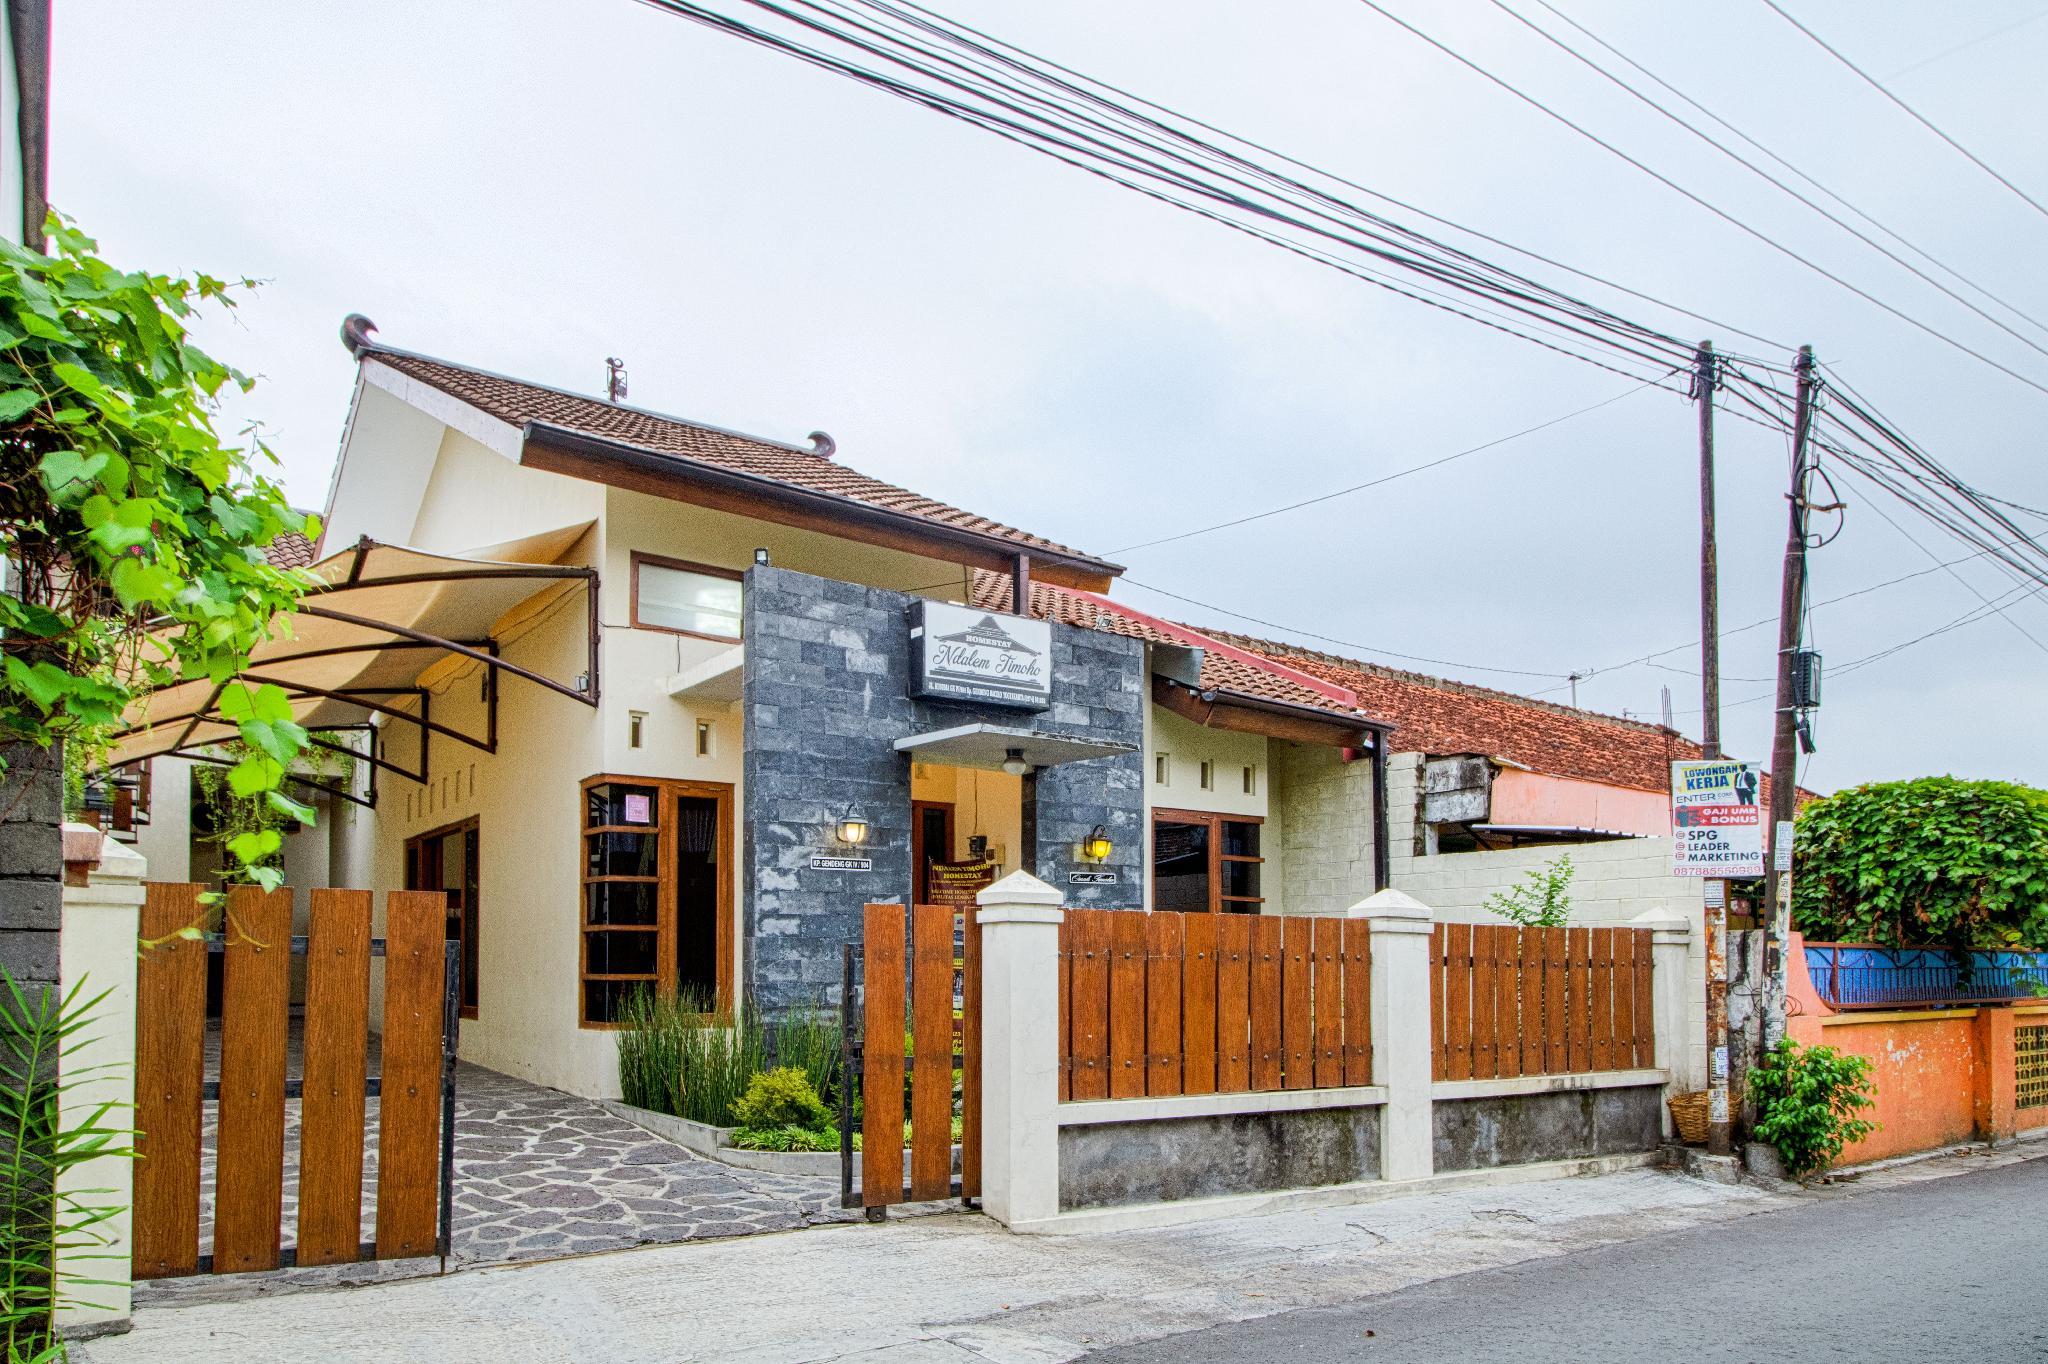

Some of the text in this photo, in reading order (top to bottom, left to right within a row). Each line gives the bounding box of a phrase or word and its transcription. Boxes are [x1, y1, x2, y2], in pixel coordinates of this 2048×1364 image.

[966, 635, 1011, 648] HOMESTAY
[933, 645, 1041, 676] Ndalem Timoho
[1684, 765, 1738, 778] LOWONGAN
[1686, 776, 1729, 790] KERJA
[1677, 793, 1716, 803] ENTER
[1688, 830, 1718, 840] SPG
[1688, 852, 1759, 861] MARKETING
